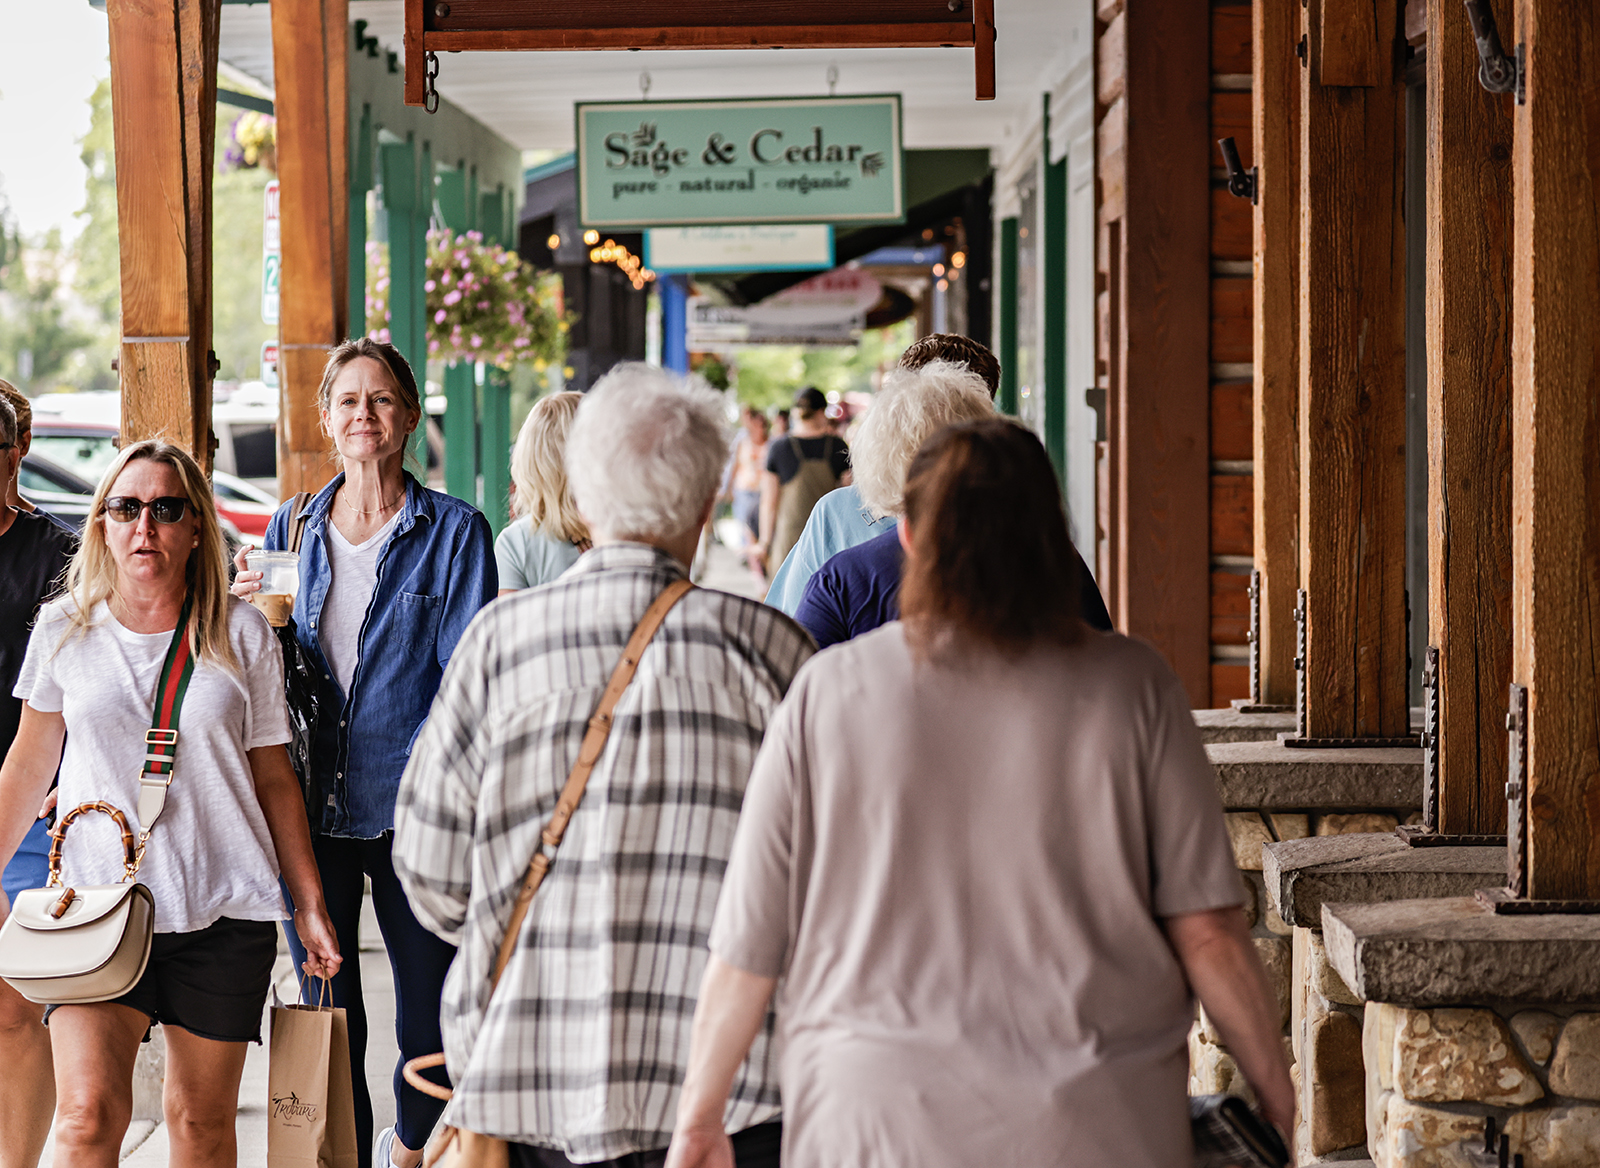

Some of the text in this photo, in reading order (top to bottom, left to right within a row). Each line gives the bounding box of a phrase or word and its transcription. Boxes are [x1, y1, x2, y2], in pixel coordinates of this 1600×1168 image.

[605, 126, 863, 177] Sage & Cedar
[613, 180, 658, 199] pure
[679, 169, 755, 192] natural
[776, 171, 851, 194] organic
